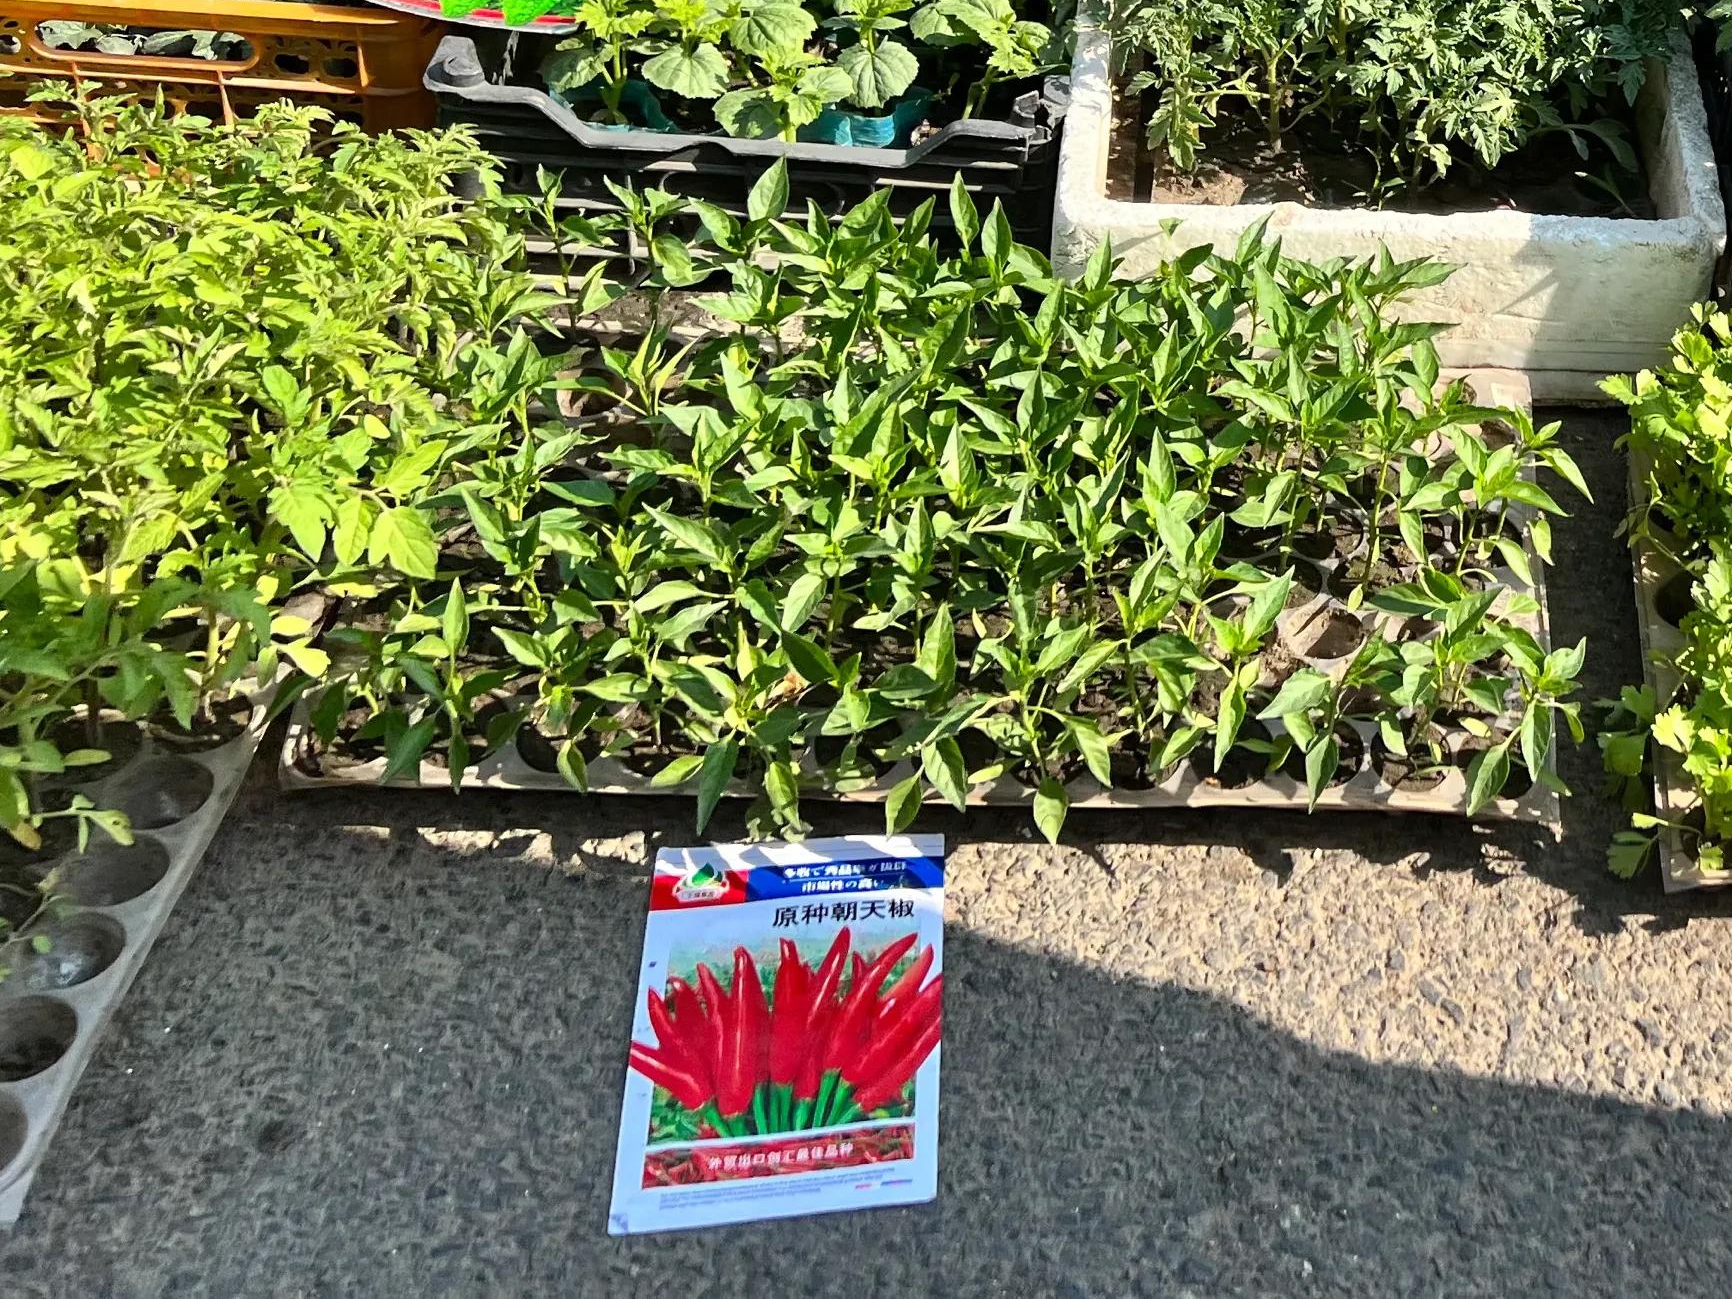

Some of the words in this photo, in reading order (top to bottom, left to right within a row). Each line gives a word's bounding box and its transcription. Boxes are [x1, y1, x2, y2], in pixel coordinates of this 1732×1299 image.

[772, 899, 914, 928] 原种朝天椒
[708, 1142, 853, 1171] 外贸出口创汇最佳品种
